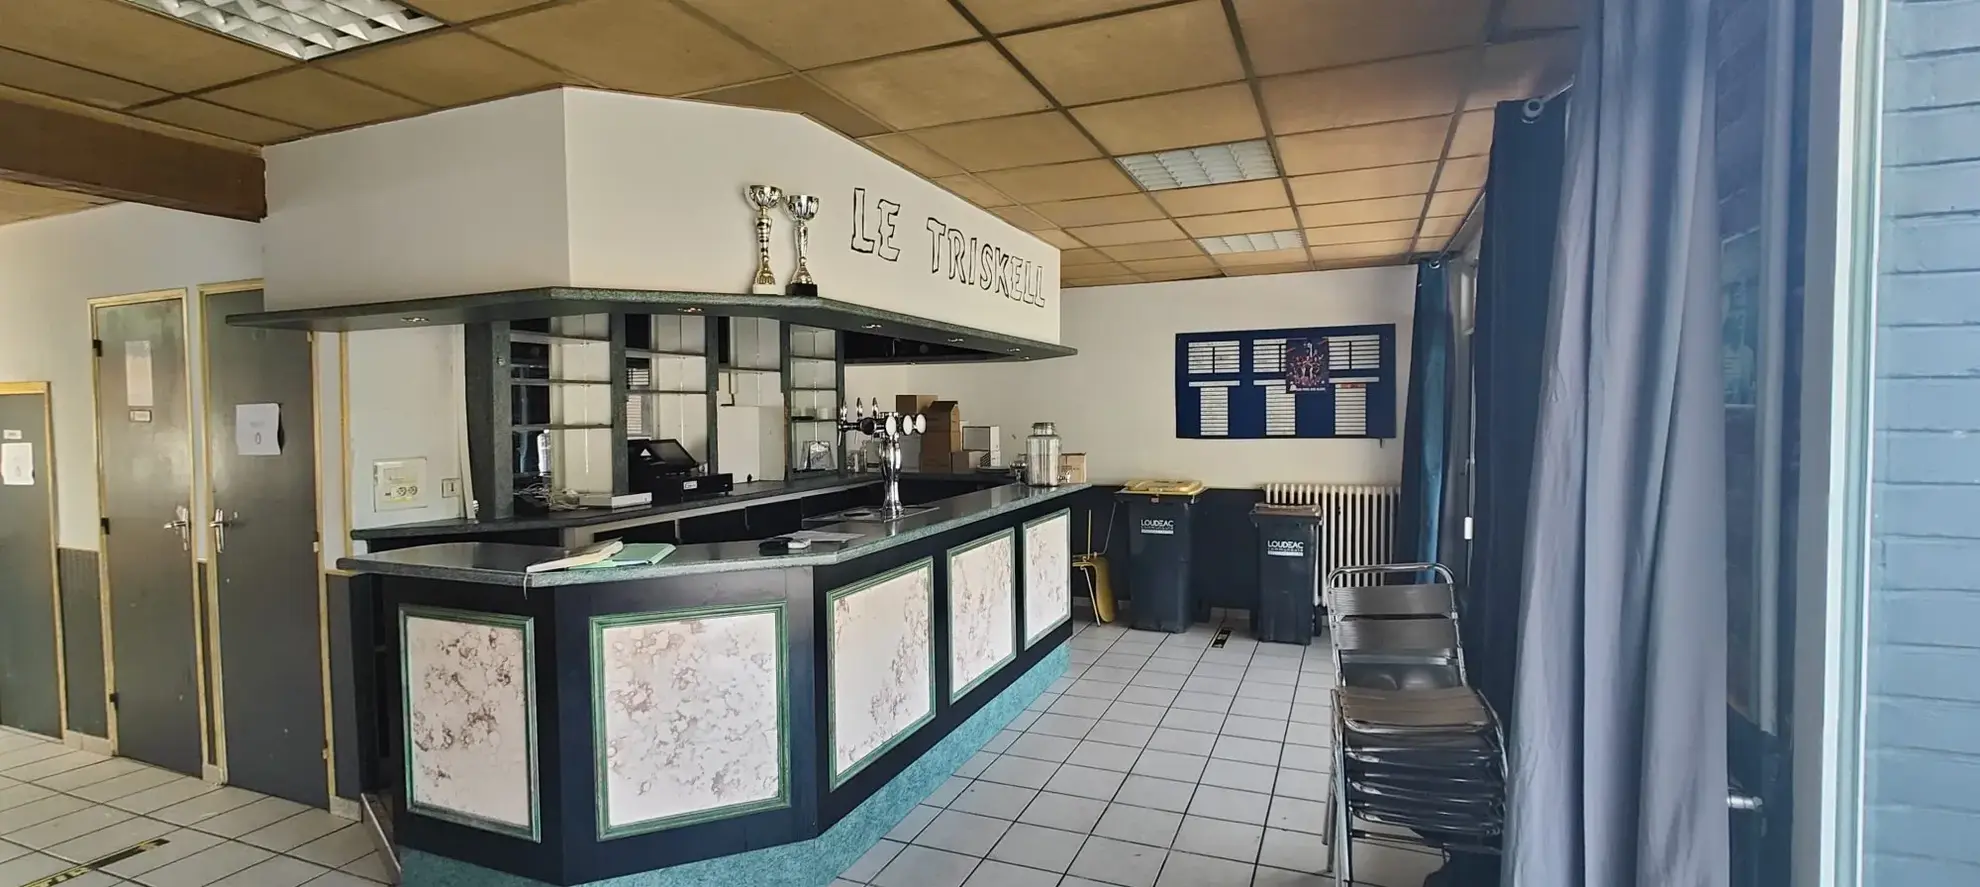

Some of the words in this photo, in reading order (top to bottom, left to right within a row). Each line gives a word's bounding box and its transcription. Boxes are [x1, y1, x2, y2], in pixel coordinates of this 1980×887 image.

[851, 187, 901, 261] LE
[926, 216, 1046, 308] TRISKELL
[1267, 540, 1304, 548] LOUDEAC
